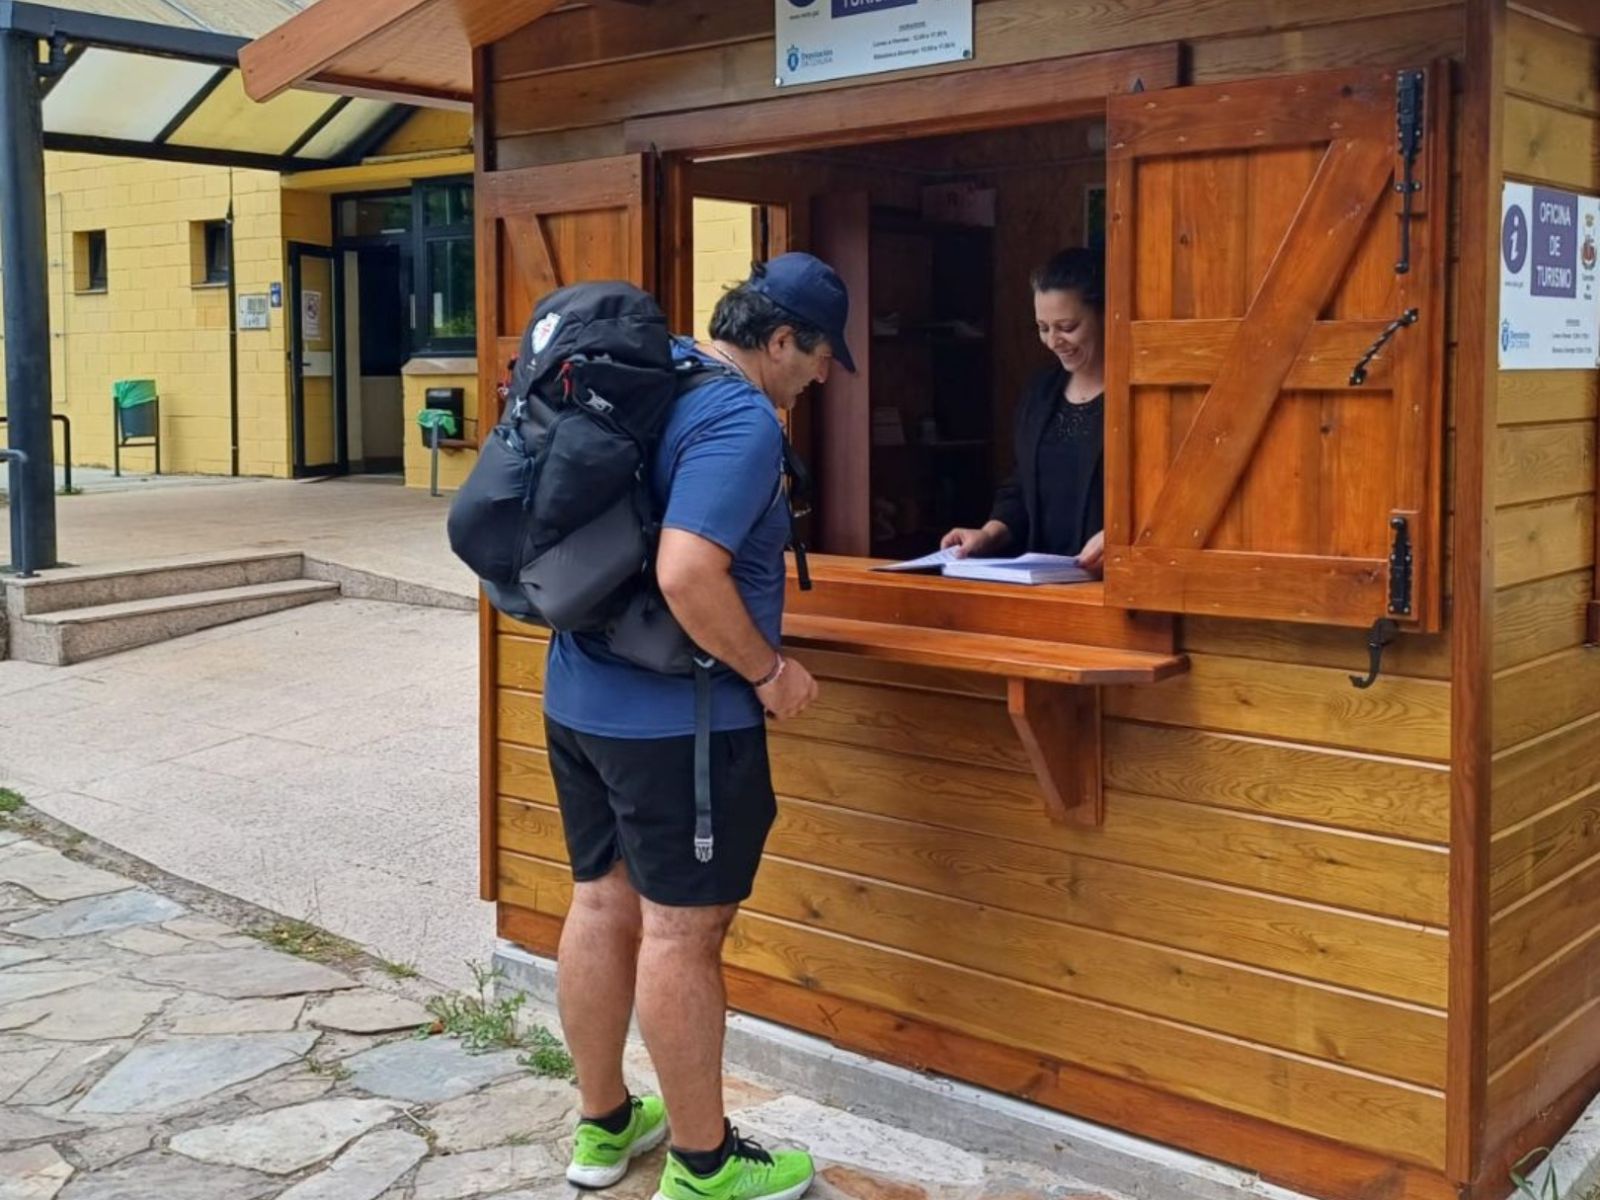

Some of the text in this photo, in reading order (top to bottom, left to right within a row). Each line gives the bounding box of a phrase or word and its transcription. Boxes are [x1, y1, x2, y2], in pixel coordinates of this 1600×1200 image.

[1540, 201, 1571, 226] OFICINA
[1549, 235, 1561, 257] DE
[1536, 265, 1572, 289] TURISMO
